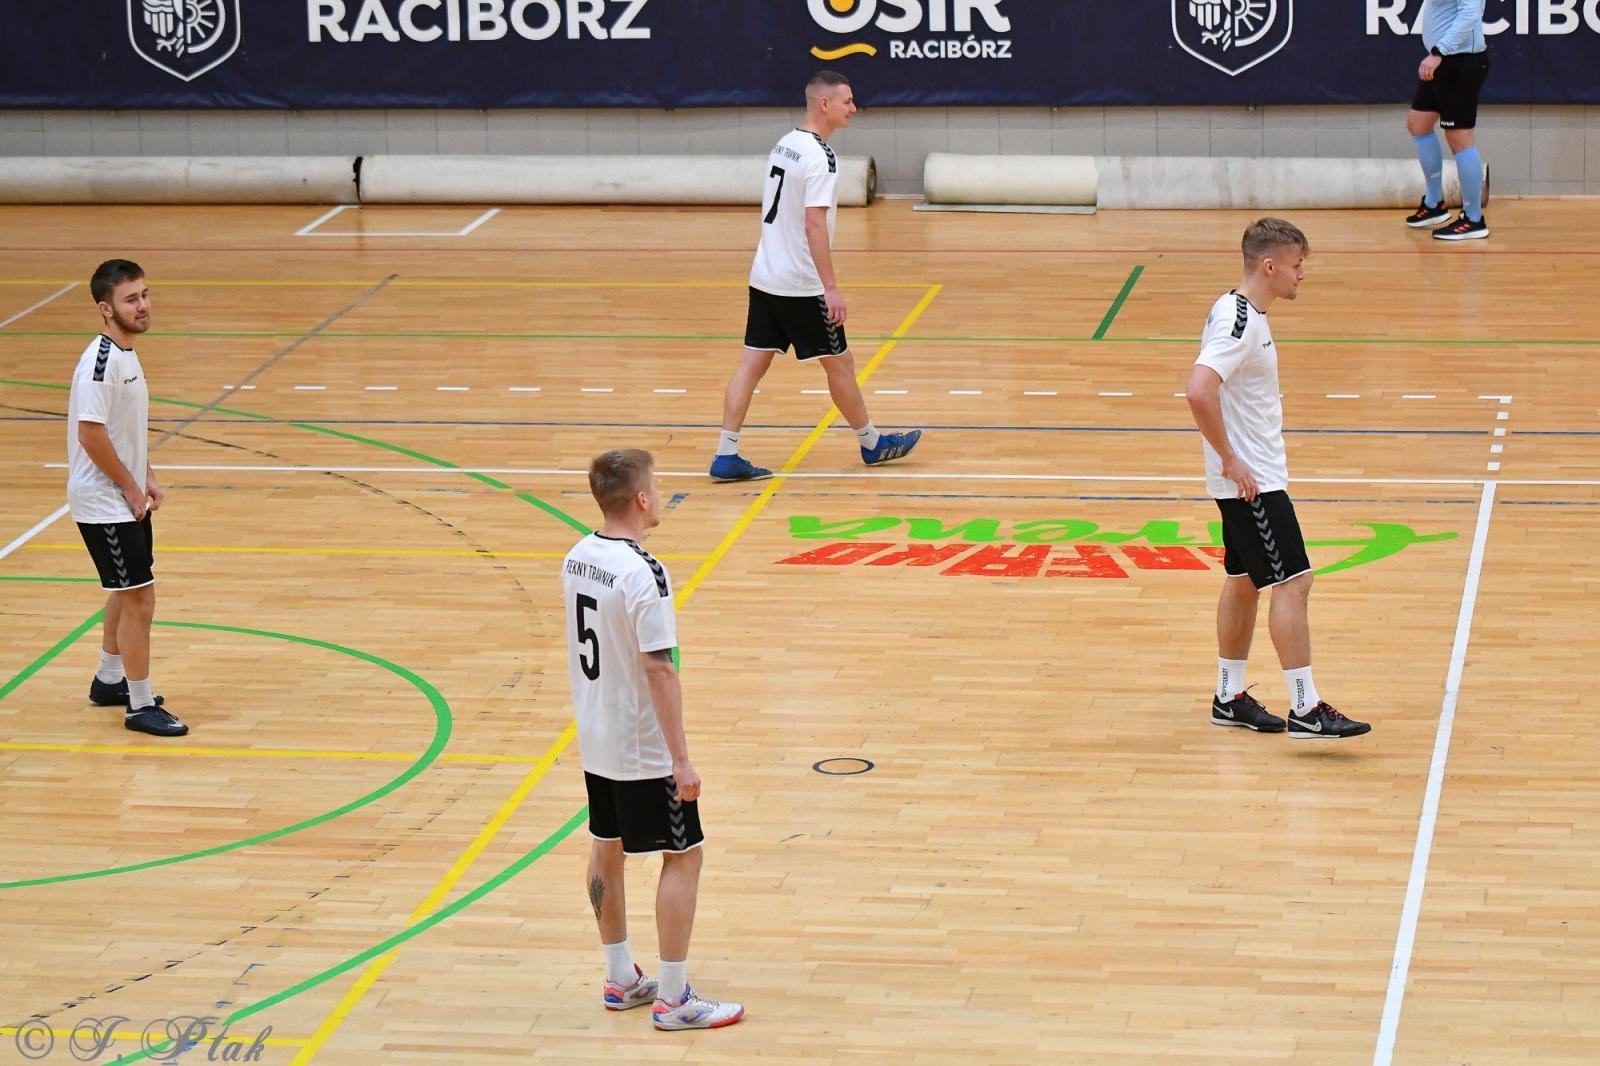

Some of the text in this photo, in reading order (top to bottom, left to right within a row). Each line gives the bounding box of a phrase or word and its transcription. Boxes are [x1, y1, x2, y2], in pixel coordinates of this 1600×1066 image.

[889, 34, 1013, 60] RACIBÓRZ
[763, 165, 786, 225] 7
[576, 592, 600, 681] 5
